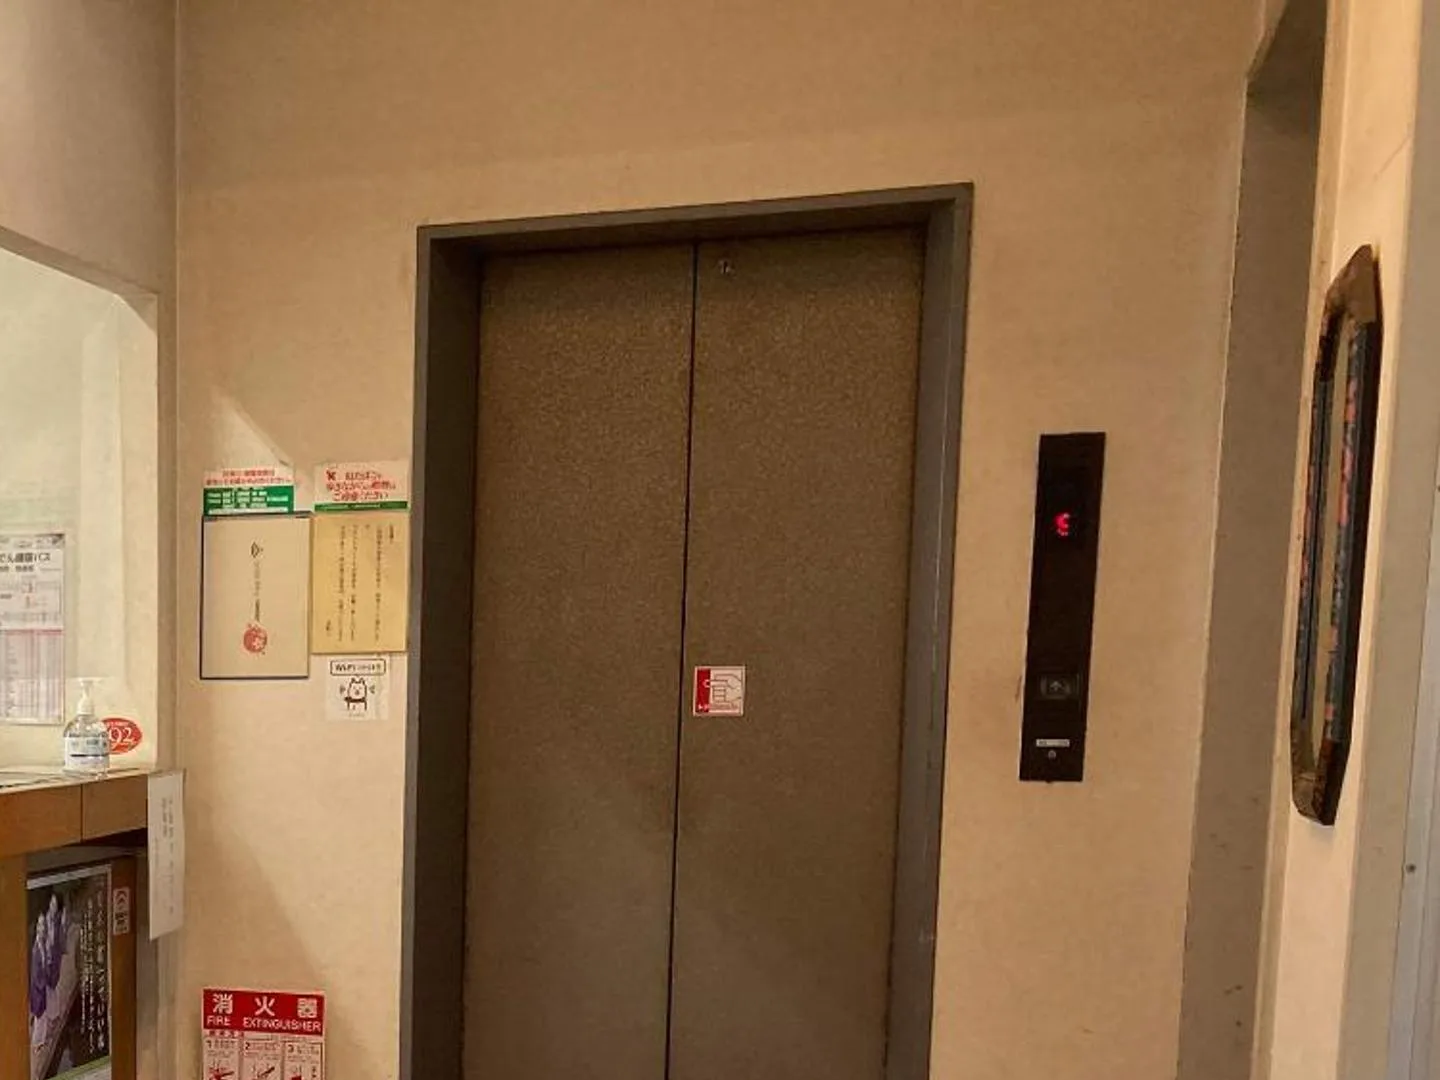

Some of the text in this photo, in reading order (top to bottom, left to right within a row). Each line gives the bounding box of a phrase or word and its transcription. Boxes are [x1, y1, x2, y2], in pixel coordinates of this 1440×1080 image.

[213, 993, 317, 1019] 消火器
[207, 1015, 321, 1032] FIRE EXTINGUISHER
